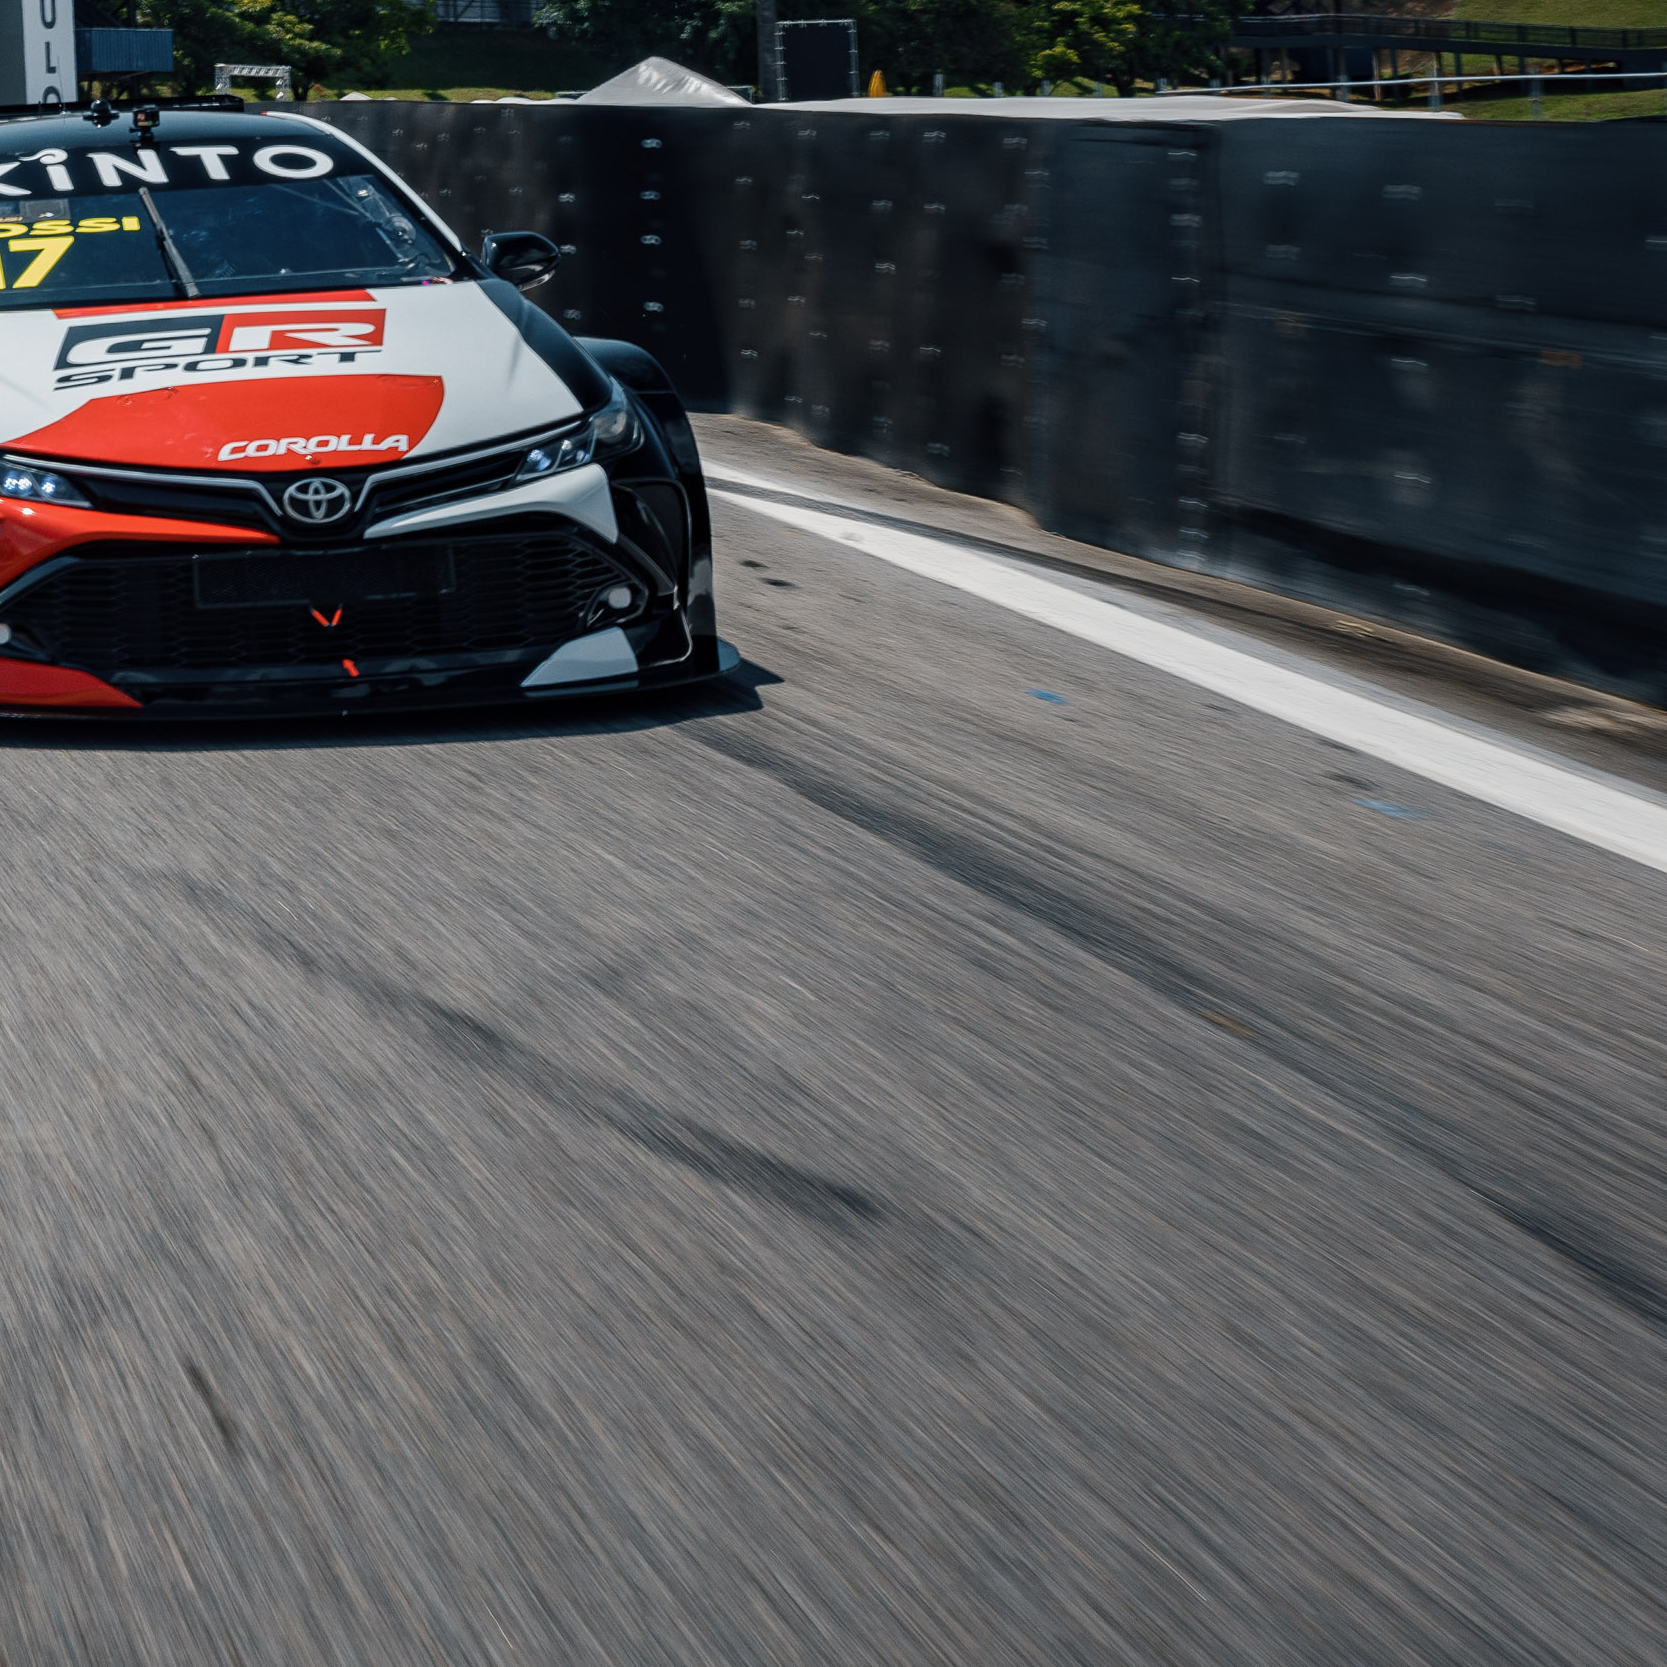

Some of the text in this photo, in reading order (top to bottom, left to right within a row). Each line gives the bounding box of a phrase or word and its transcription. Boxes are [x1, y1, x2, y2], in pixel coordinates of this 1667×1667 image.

[66, 321, 376, 365] GR
[54, 350, 383, 391] SPORT
[218, 434, 410, 461] COROLLA
